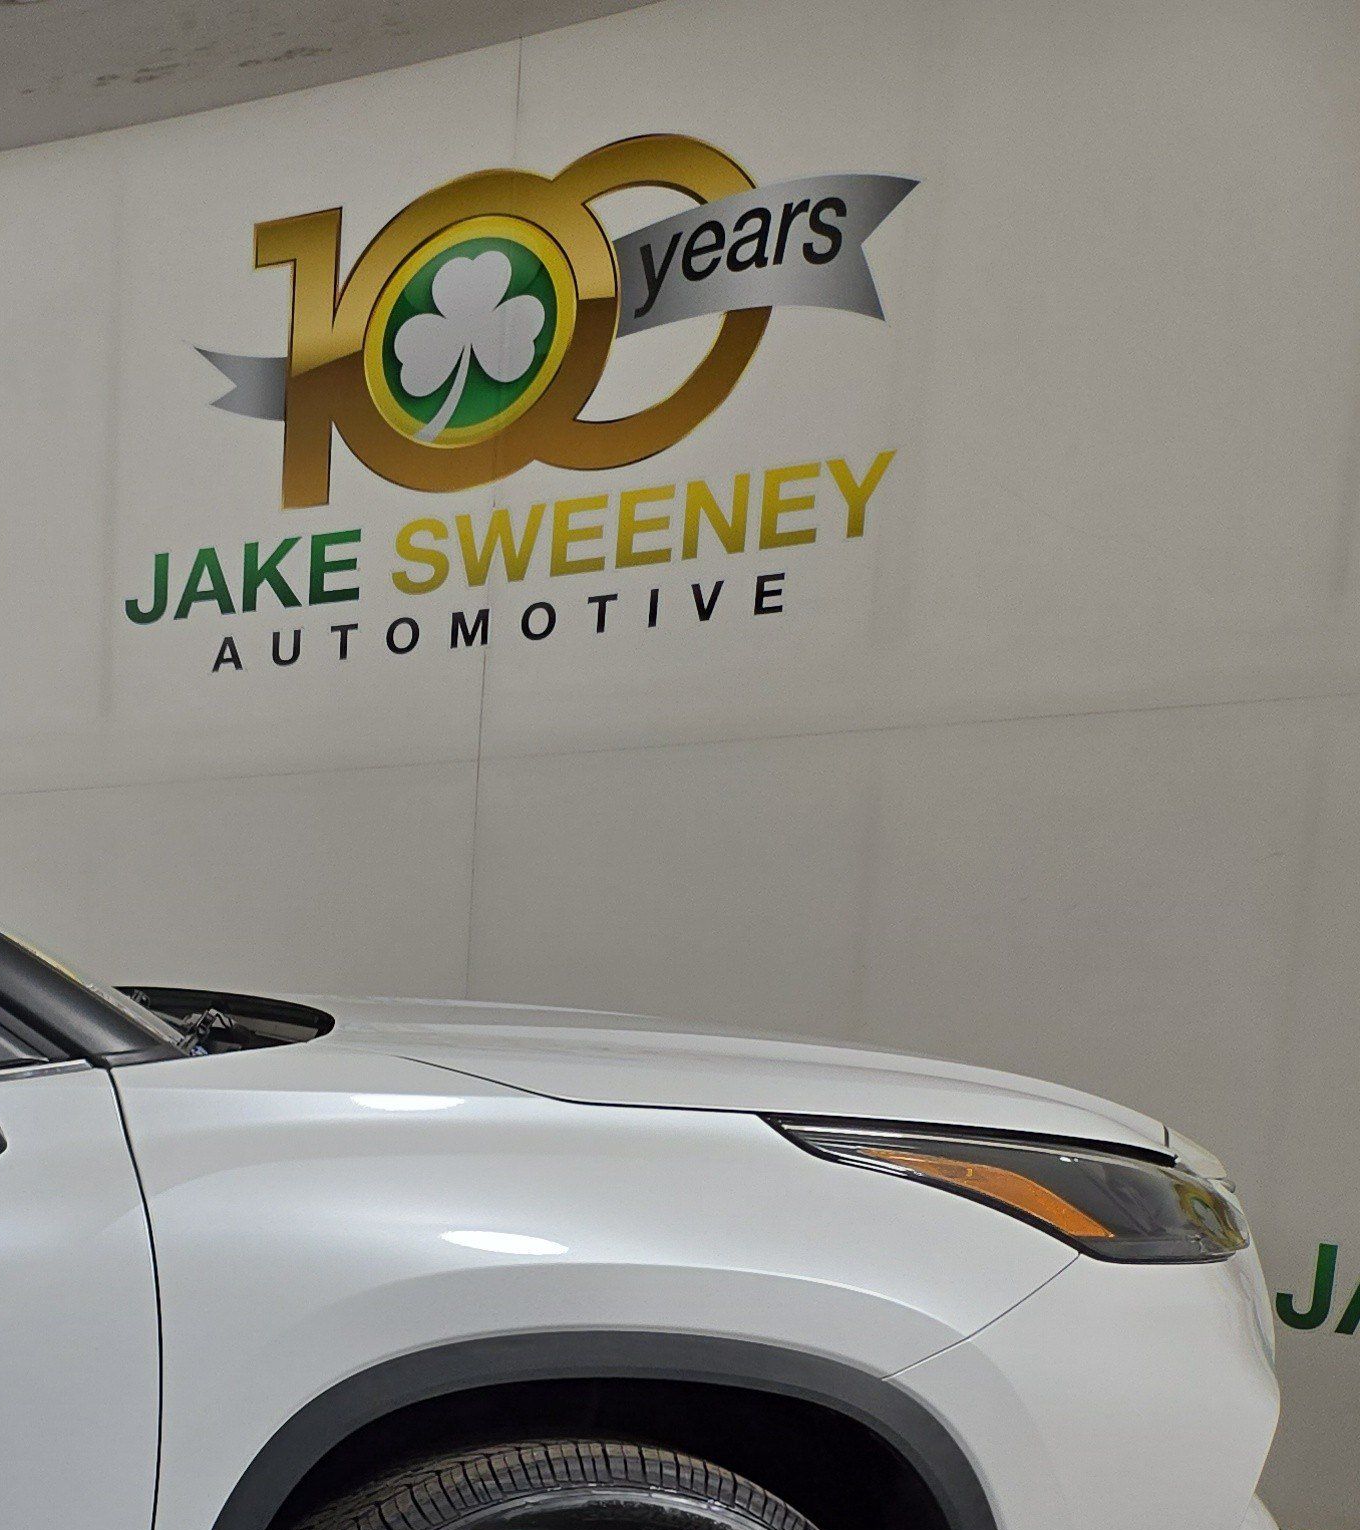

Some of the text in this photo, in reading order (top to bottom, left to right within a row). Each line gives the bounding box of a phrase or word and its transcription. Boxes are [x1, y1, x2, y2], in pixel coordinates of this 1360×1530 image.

[634, 196, 847, 319] years
[125, 450, 898, 626] JAKE SWEENEY
[212, 572, 786, 674] AUTOMOTIVE
